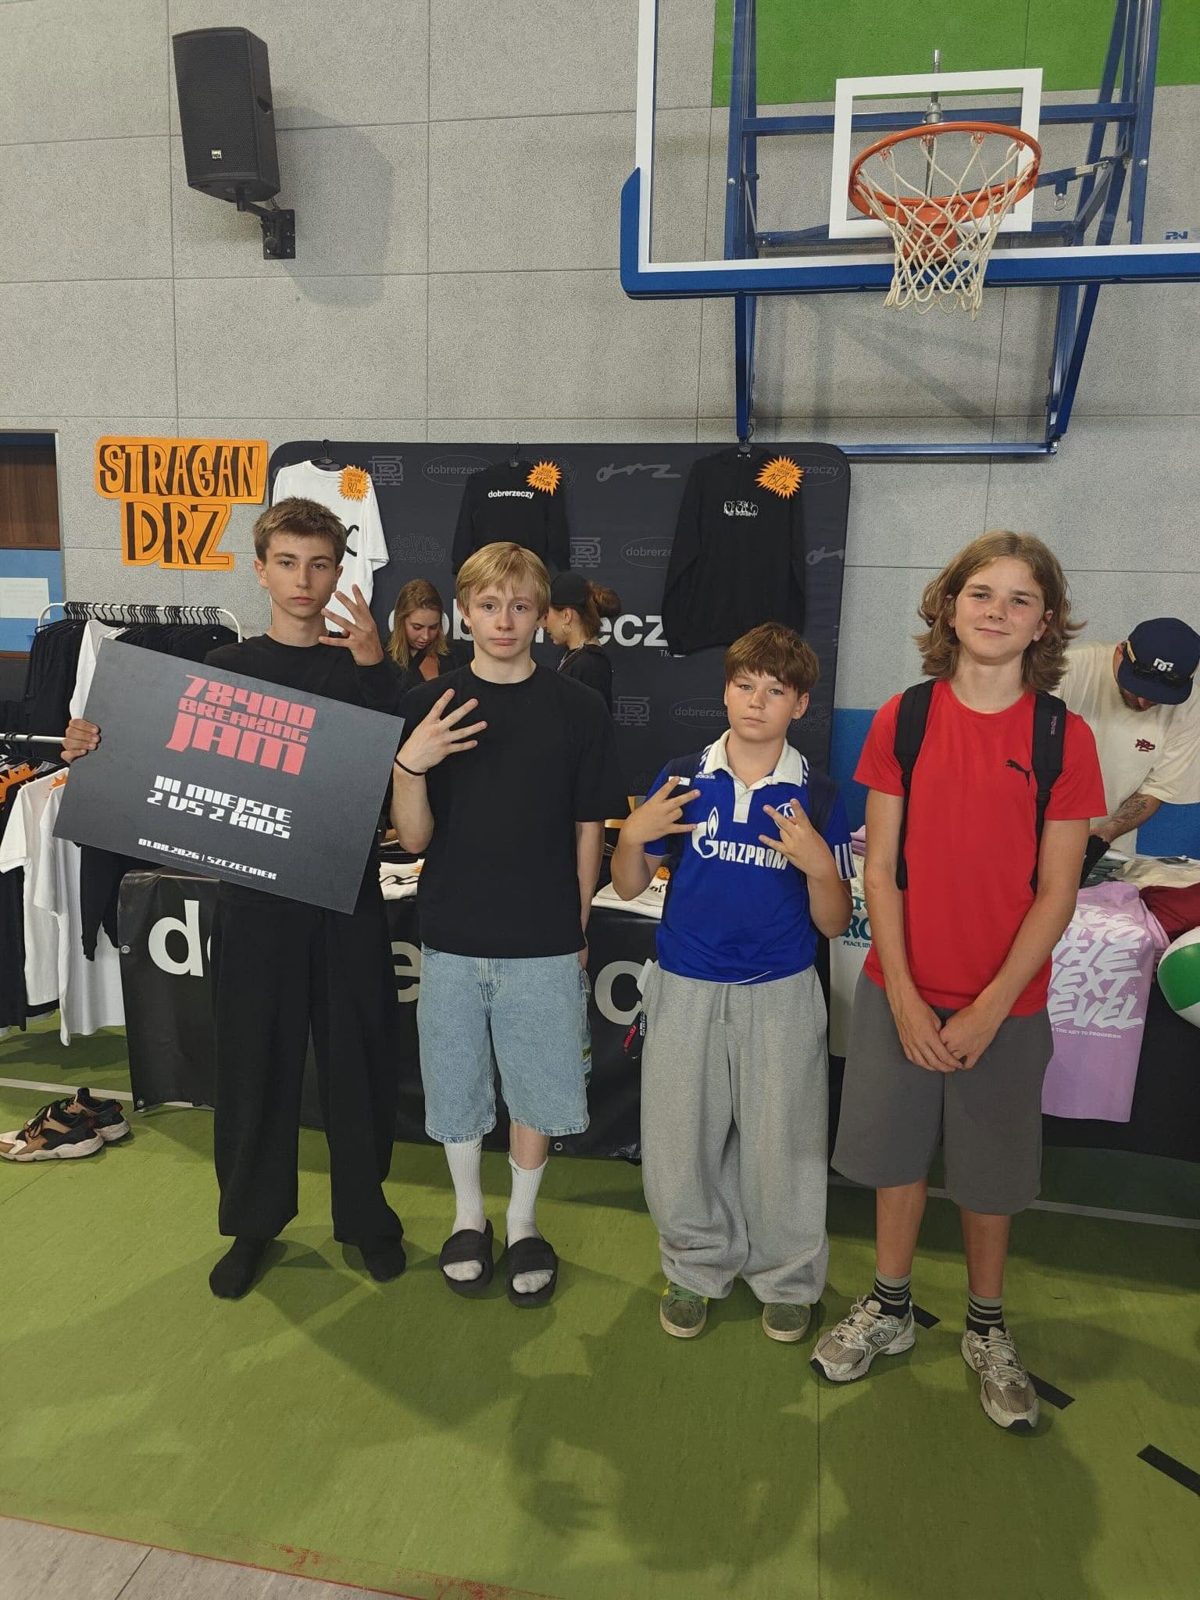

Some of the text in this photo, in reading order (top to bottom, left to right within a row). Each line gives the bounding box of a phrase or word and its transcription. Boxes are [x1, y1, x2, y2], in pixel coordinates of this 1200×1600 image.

[99, 444, 260, 497] STRAGAN
[488, 490, 534, 499] dobrerzeczy
[126, 501, 230, 564] DRZ
[626, 546, 672, 556] dobrerze
[178, 697, 311, 743] BREAKING
[184, 674, 317, 729] 78400
[674, 706, 728, 718] dobrerzec
[165, 712, 307, 775] JAM
[146, 790, 292, 839] 2 VS 2 KIDS
[154, 775, 293, 824] III MIEJSCE
[138, 838, 200, 860] 01.08.2026
[207, 855, 277, 880] SZCZECINEK
[719, 840, 788, 870] GAZPROM
[1052, 963, 1142, 999] EXT
[1047, 992, 1144, 1029] EVEL
